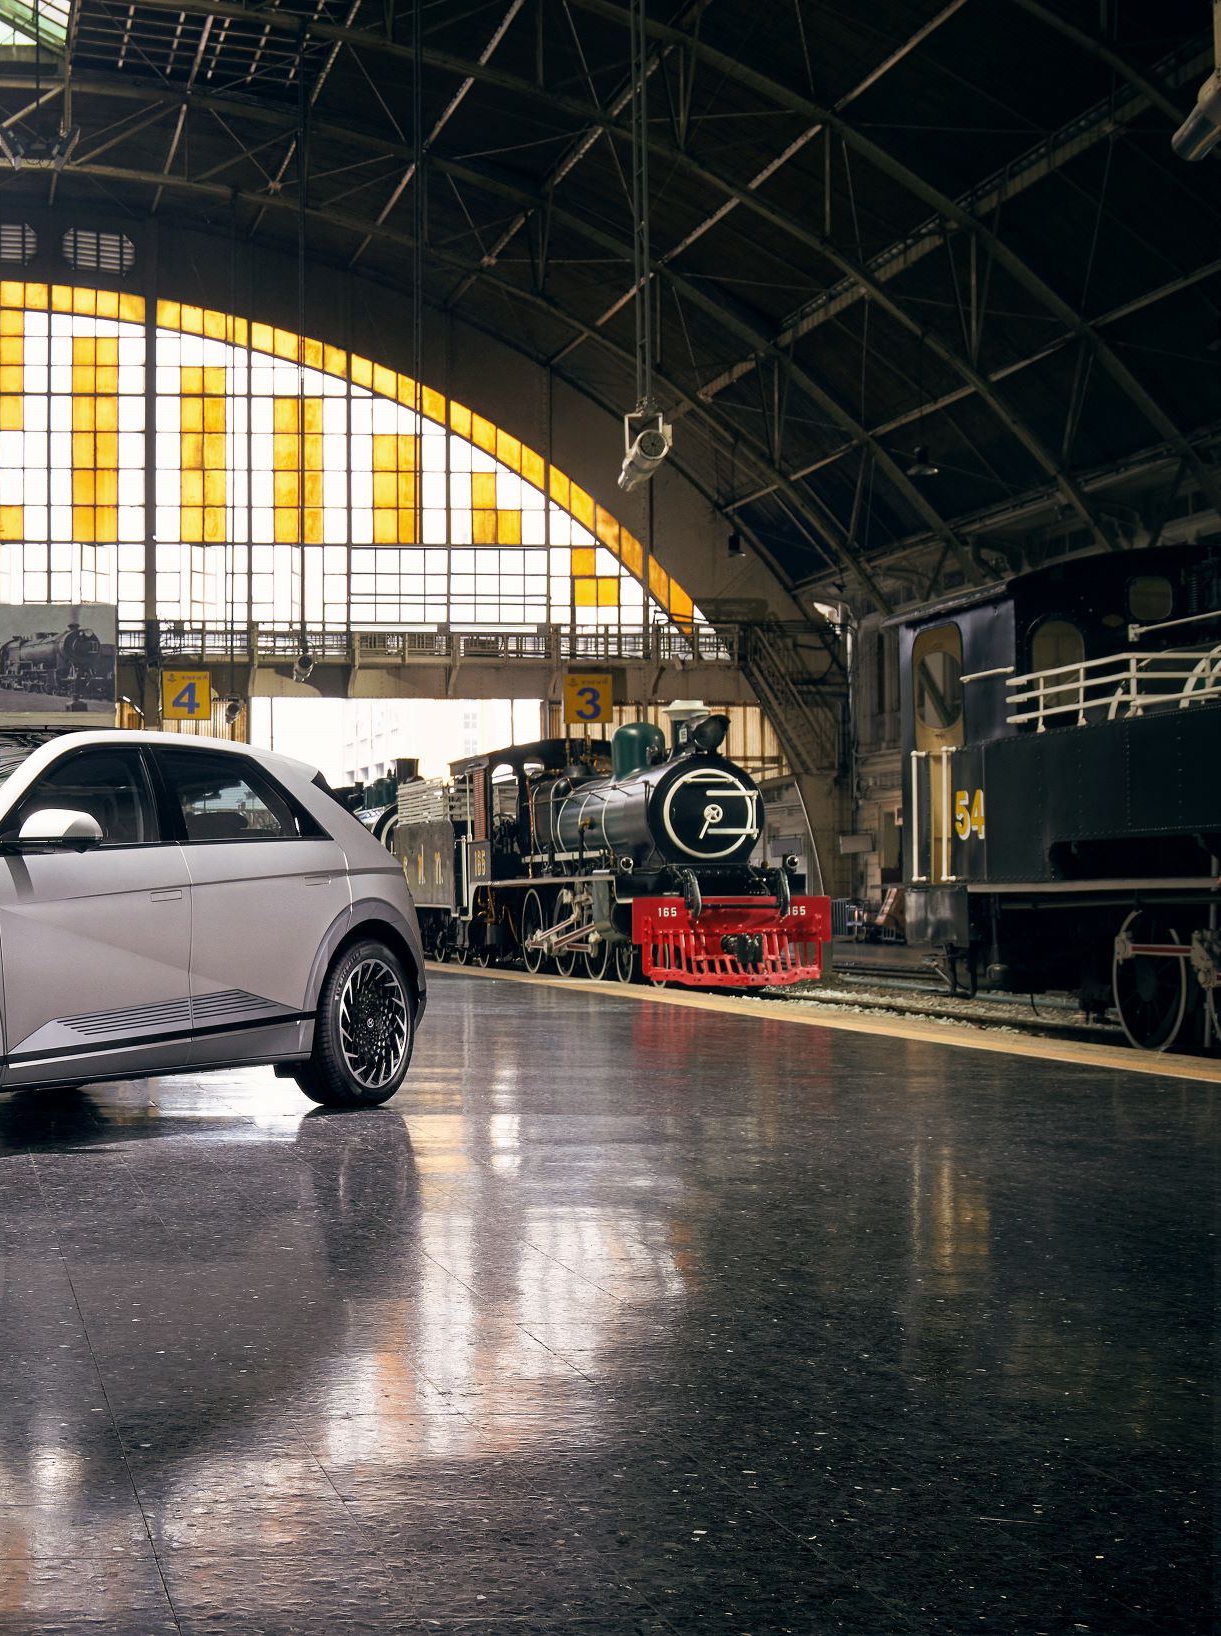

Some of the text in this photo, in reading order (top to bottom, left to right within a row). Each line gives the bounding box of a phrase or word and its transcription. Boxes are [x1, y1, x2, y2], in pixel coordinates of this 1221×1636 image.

[172, 682, 200, 715] 4
[576, 687, 602, 720] 3
[955, 788, 985, 840] 54
[658, 907, 677, 918] 165
